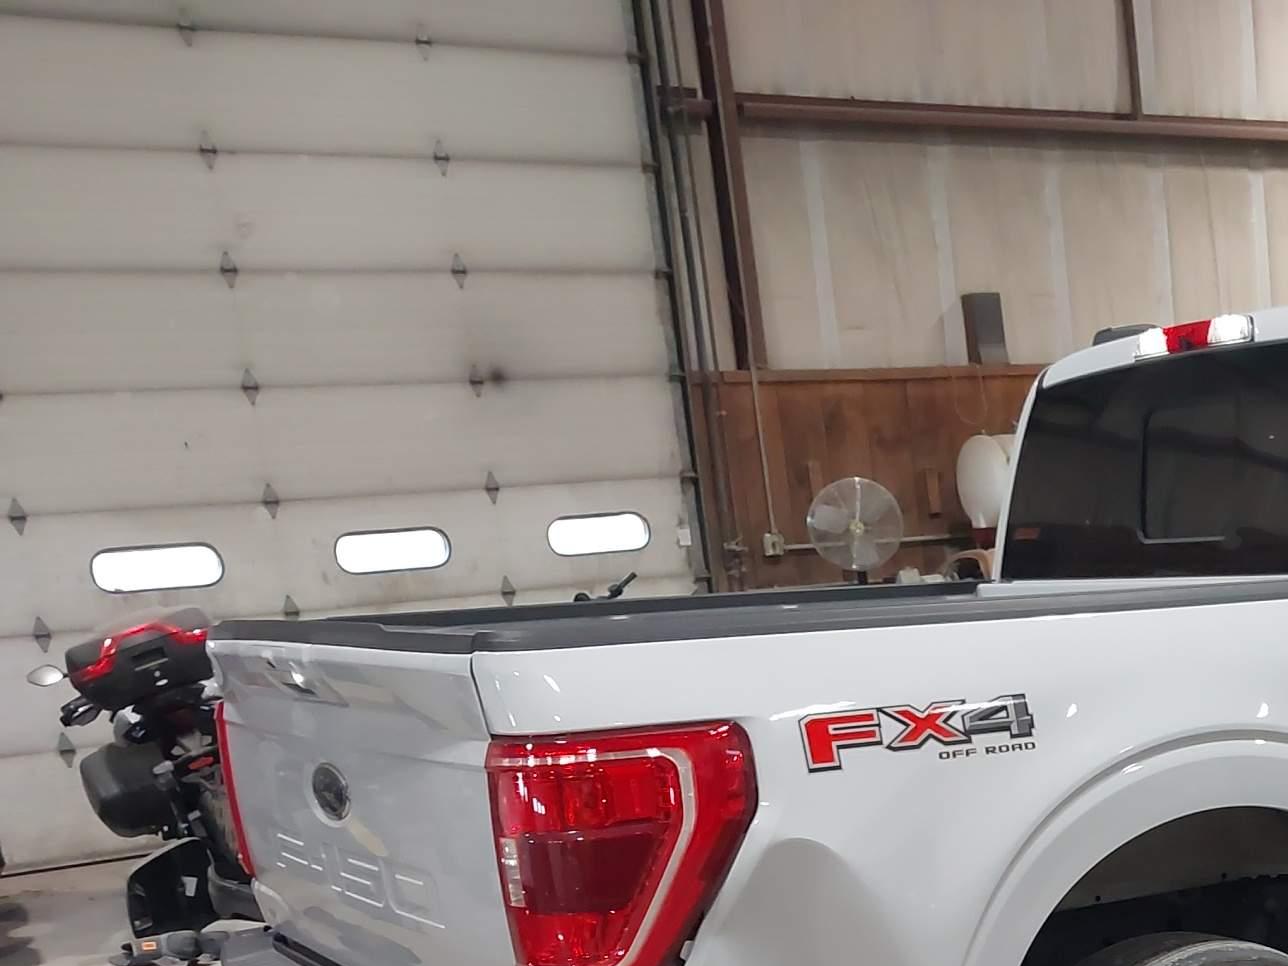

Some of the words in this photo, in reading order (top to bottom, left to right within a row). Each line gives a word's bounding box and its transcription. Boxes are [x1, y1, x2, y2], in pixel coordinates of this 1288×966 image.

[798, 692, 1034, 773] FX4
[938, 747, 977, 760] OFF
[984, 741, 1036, 755] ROAD
